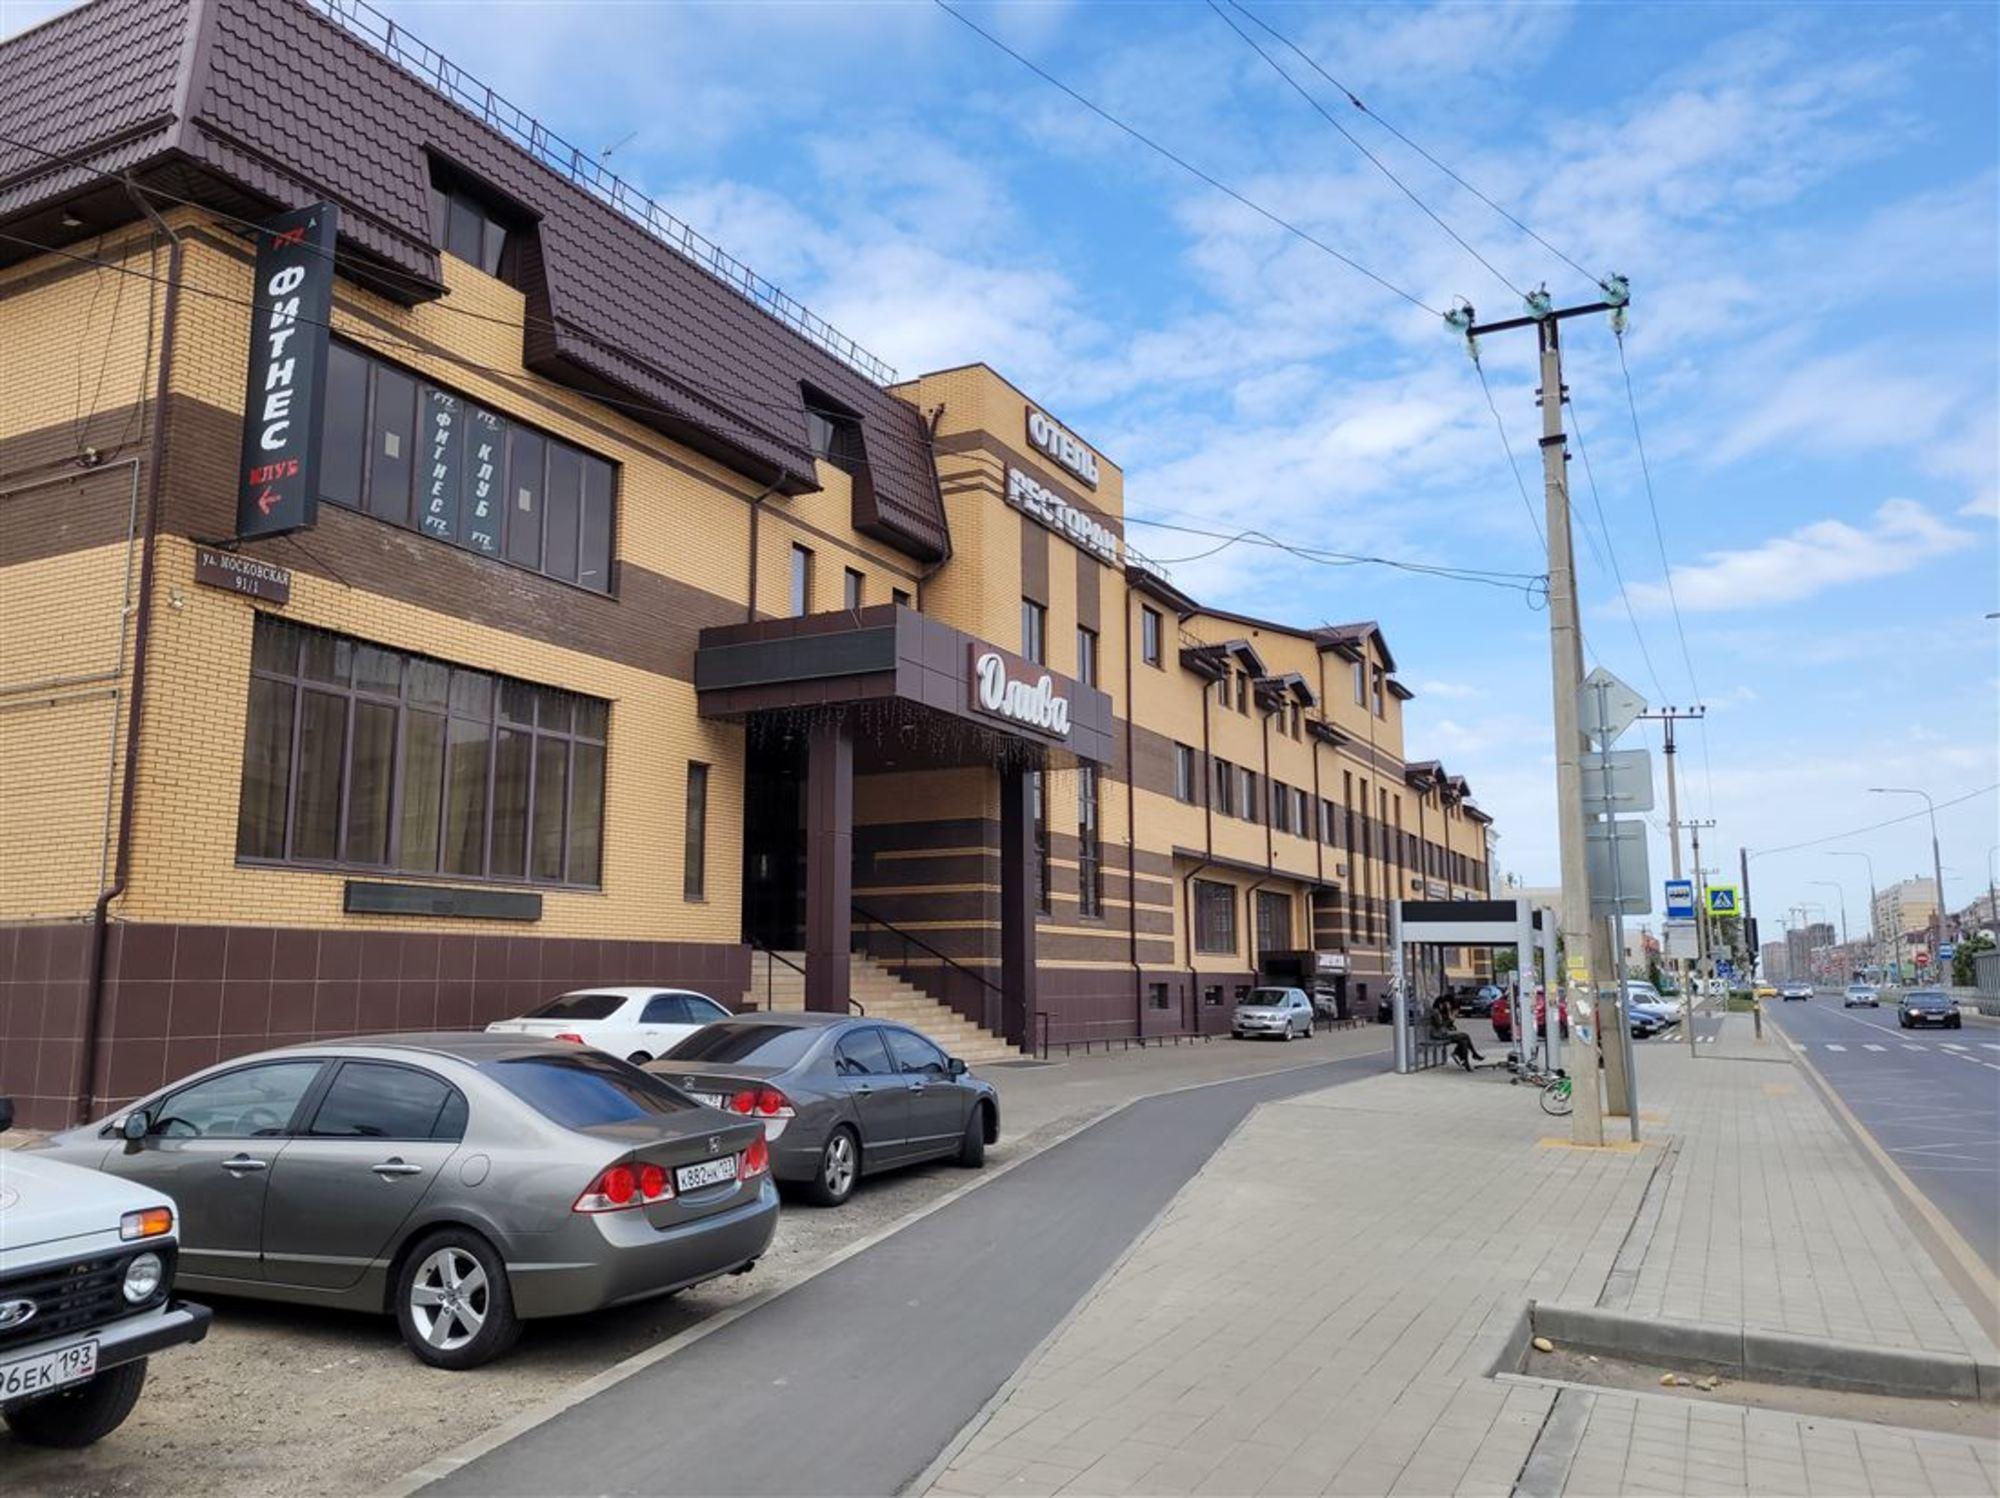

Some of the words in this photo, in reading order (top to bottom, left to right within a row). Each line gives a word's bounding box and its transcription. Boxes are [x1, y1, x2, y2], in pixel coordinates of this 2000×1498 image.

[261, 265, 305, 450] ФИТНЕС
[430, 412, 451, 513] ФИТНЕС
[475, 443, 493, 517] КЛУБ
[1029, 412, 1099, 488] ОТЕЛЬ
[1008, 467, 1117, 563] РЕСТОРАН
[220, 555, 290, 587] МОСКОВСКАЯ
[235, 575, 259, 594] 91/1
[60, 1345, 91, 1372] 193
